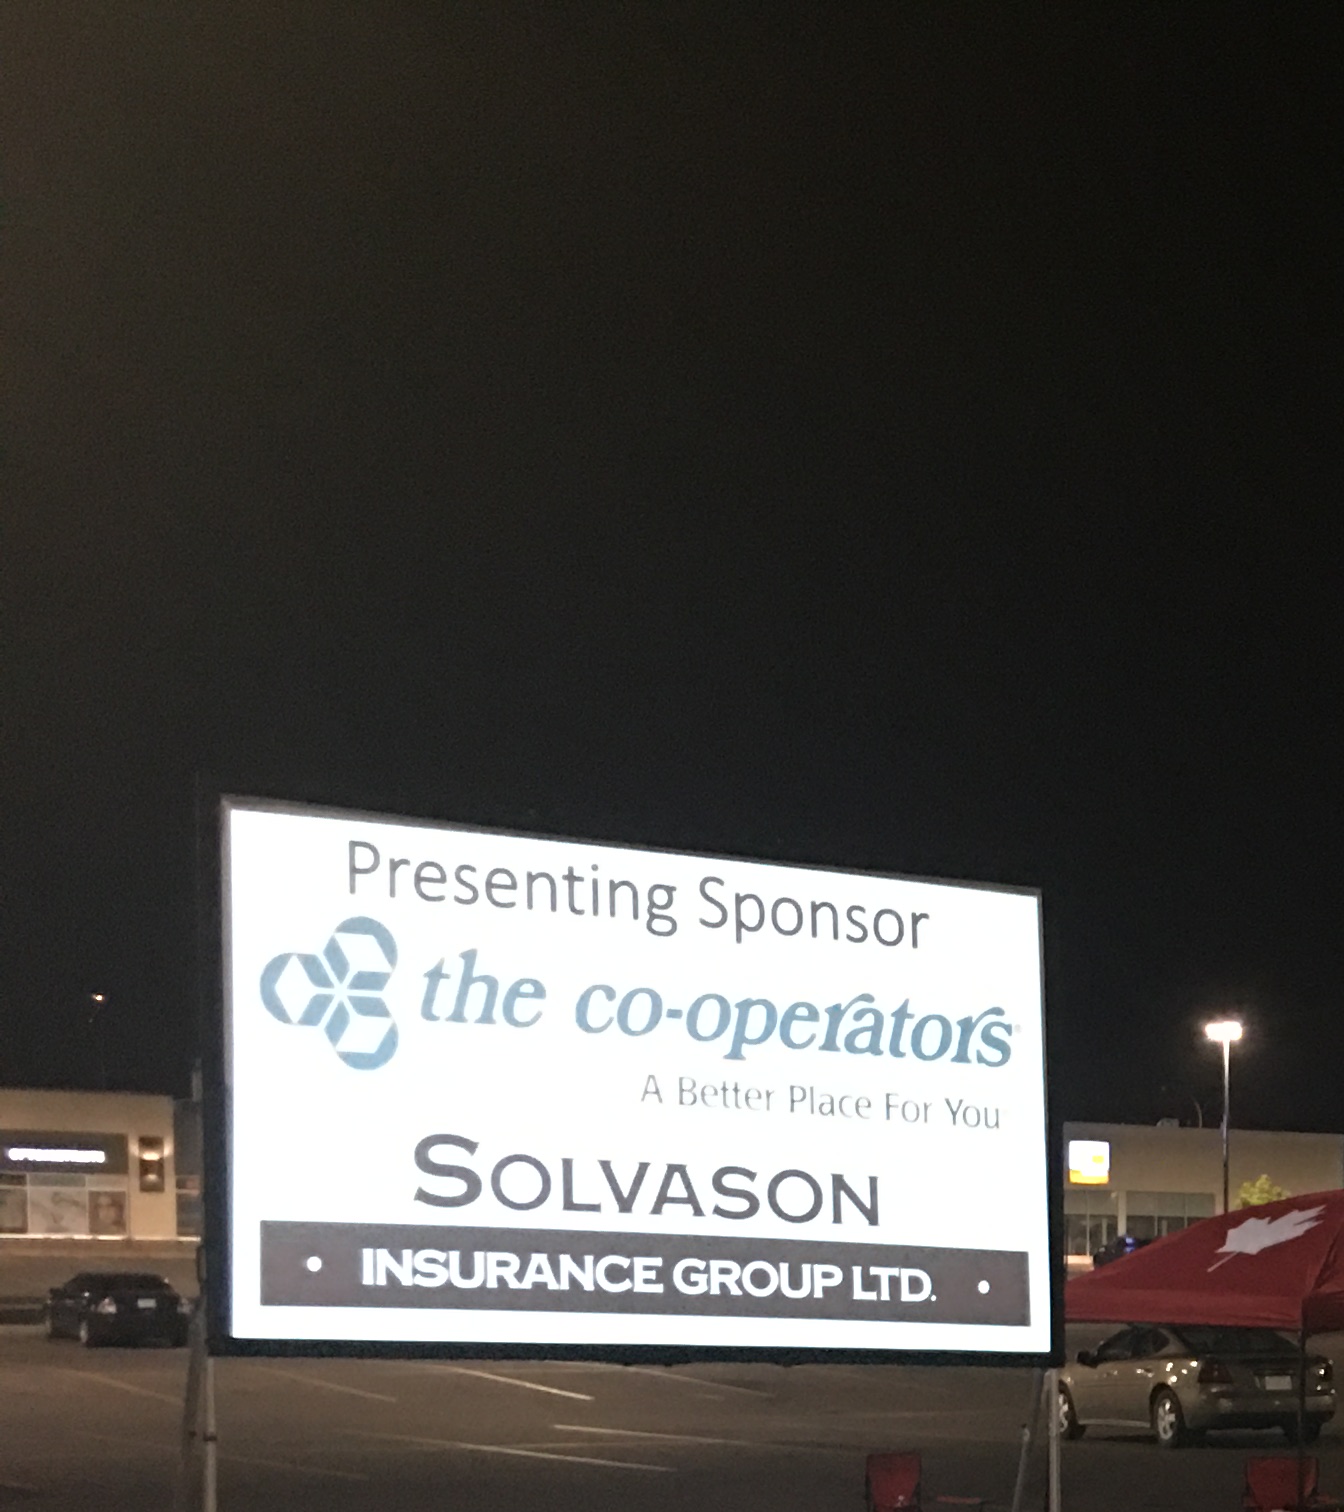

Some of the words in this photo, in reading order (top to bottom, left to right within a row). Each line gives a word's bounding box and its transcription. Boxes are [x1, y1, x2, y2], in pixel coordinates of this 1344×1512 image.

[347, 840, 677, 937] Presenting
[700, 877, 929, 948] Sponsor
[421, 949, 546, 1028] the
[576, 985, 1012, 1067] co-operators
[641, 1075, 662, 1103] A
[679, 1077, 774, 1110] Better
[790, 1085, 871, 1118] Place
[886, 1093, 931, 1123] For
[945, 1098, 999, 1128] You
[414, 1134, 879, 1226] SOLVASON
[362, 1248, 664, 1293] INSURANCE
[673, 1258, 843, 1298] GROUP
[852, 1266, 936, 1302] LTD.
